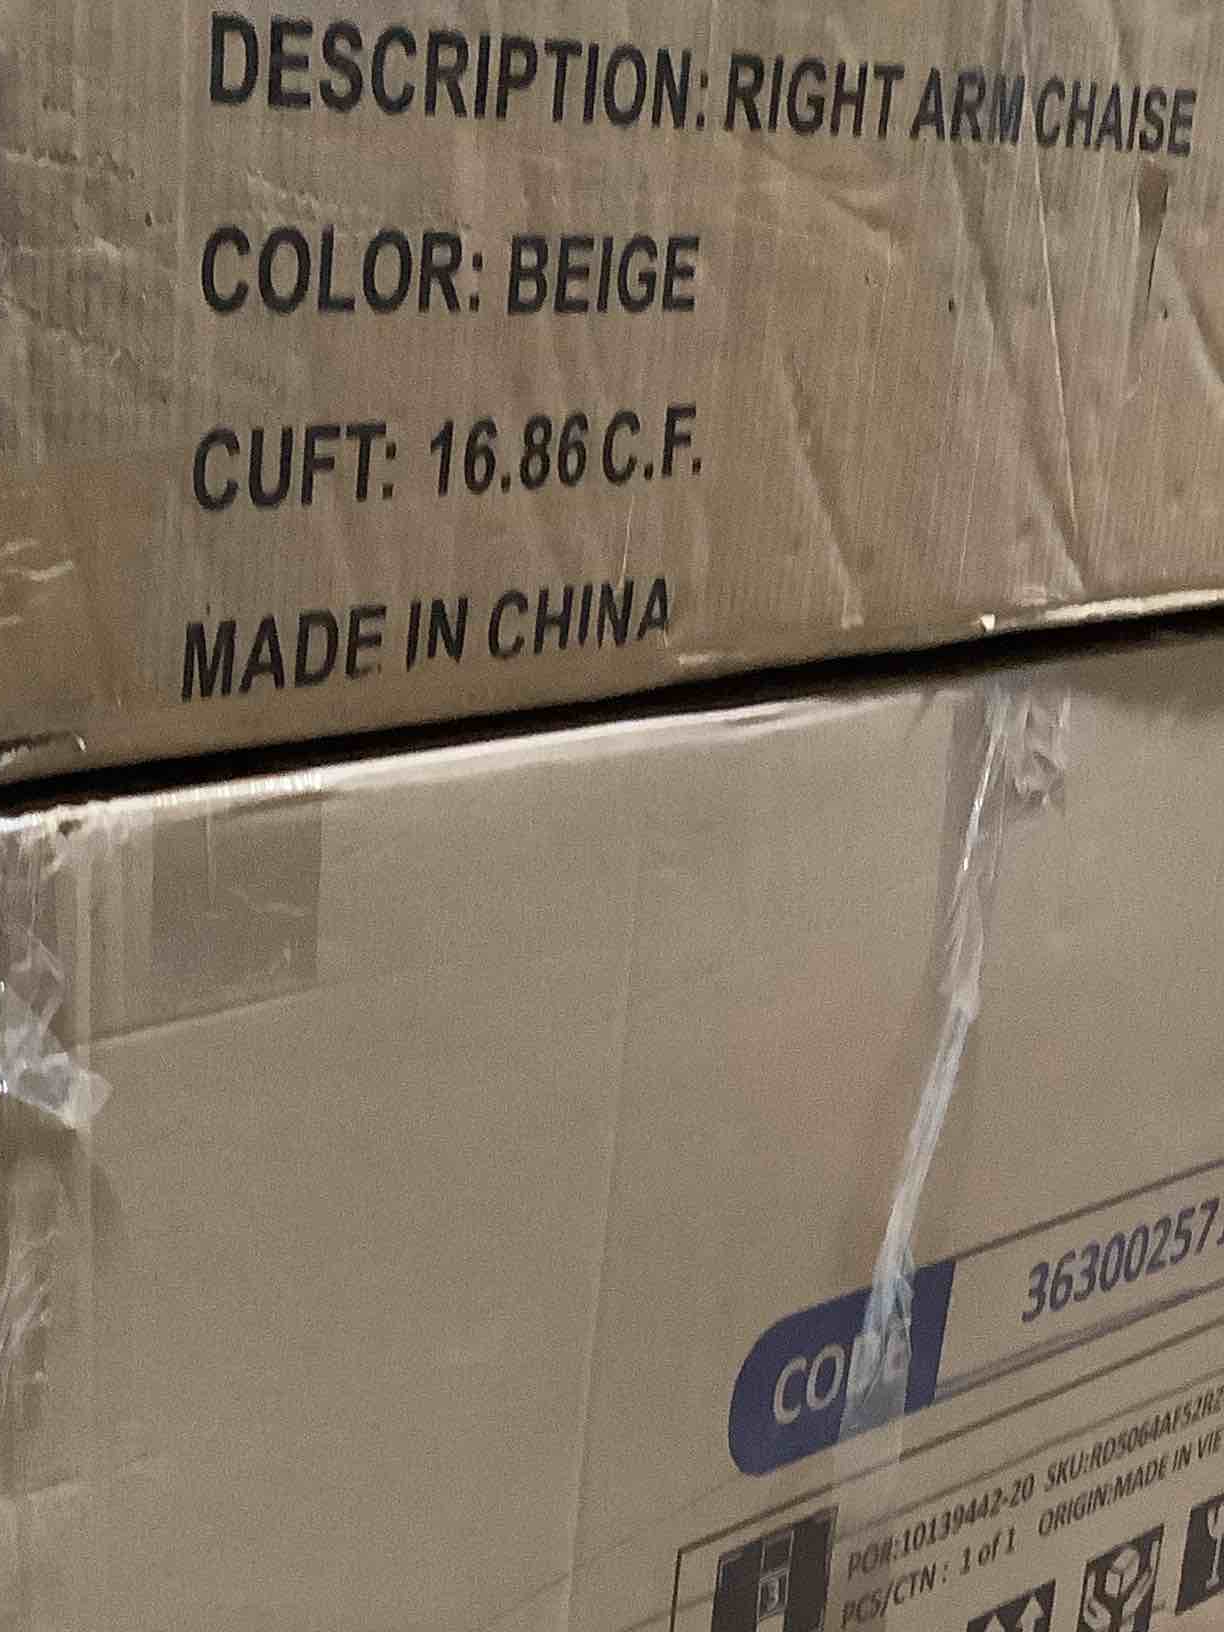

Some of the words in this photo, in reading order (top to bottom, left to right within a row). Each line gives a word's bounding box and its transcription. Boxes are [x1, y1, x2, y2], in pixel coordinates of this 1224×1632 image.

[209, 10, 710, 130] DESCRIPTION:
[723, 53, 905, 140] RIGHT
[909, 67, 1026, 146] ARM
[1034, 74, 1199, 158] CHAISE
[200, 225, 483, 316] COLOR:
[506, 234, 700, 318] BEIGE
[192, 419, 398, 513] CUFT:
[429, 412, 589, 499] 16.86
[599, 402, 704, 487] C.F.
[180, 601, 385, 705] MADE
[405, 594, 466, 674] IN
[486, 575, 674, 664] CHINA
[1021, 1196, 1224, 1323] 36300257
